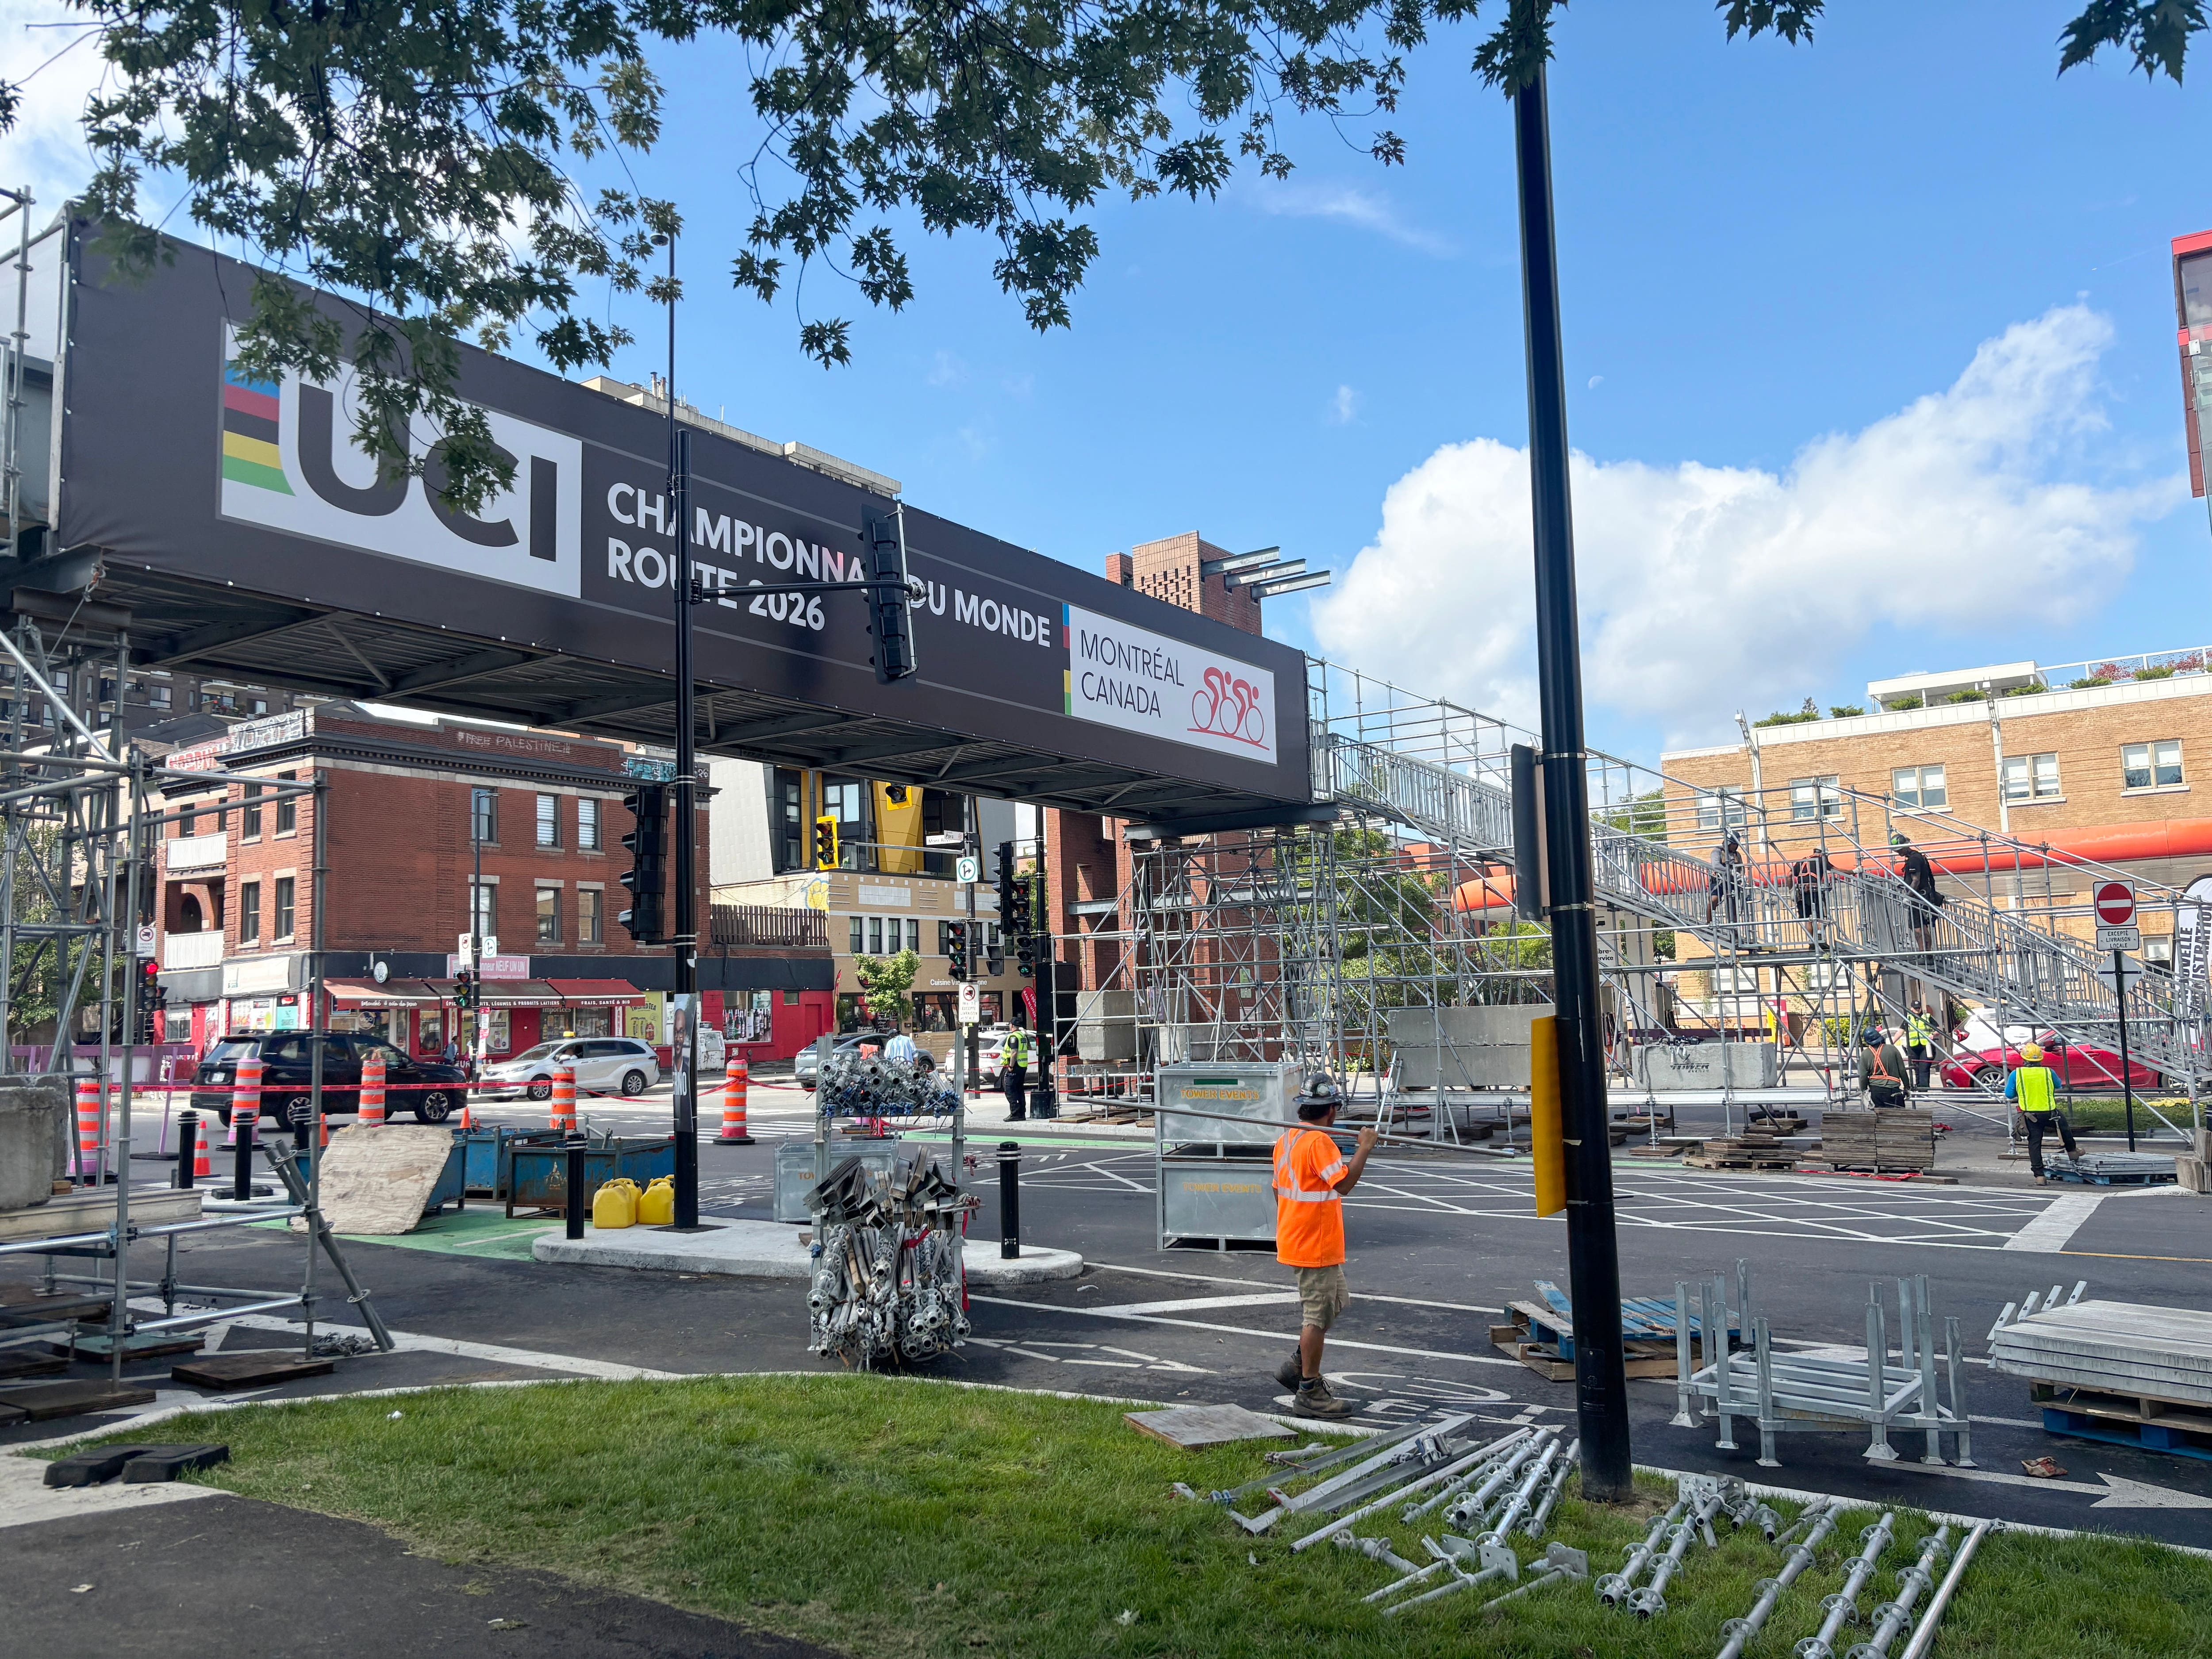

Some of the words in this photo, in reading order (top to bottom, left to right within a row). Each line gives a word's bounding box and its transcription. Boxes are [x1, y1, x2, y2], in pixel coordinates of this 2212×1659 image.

[298, 382, 557, 562] UCI
[607, 482, 869, 595] CHMPIONNA
[954, 588, 1051, 648] MONDE
[749, 579, 826, 631] 2026
[1081, 629, 1184, 687] MONTRÉAL
[1081, 671, 1162, 719] CANADA
[466, 733, 492, 745] FREE
[495, 960, 509, 972] NEUF
[510, 960, 517, 972] UN
[518, 960, 525, 972] UN
[1180, 1089, 1217, 1099] TOWER
[1219, 1089, 1260, 1100] EVENTS
[1182, 1182, 1220, 1193] TOWER
[1221, 1182, 1262, 1194] EVENTS
